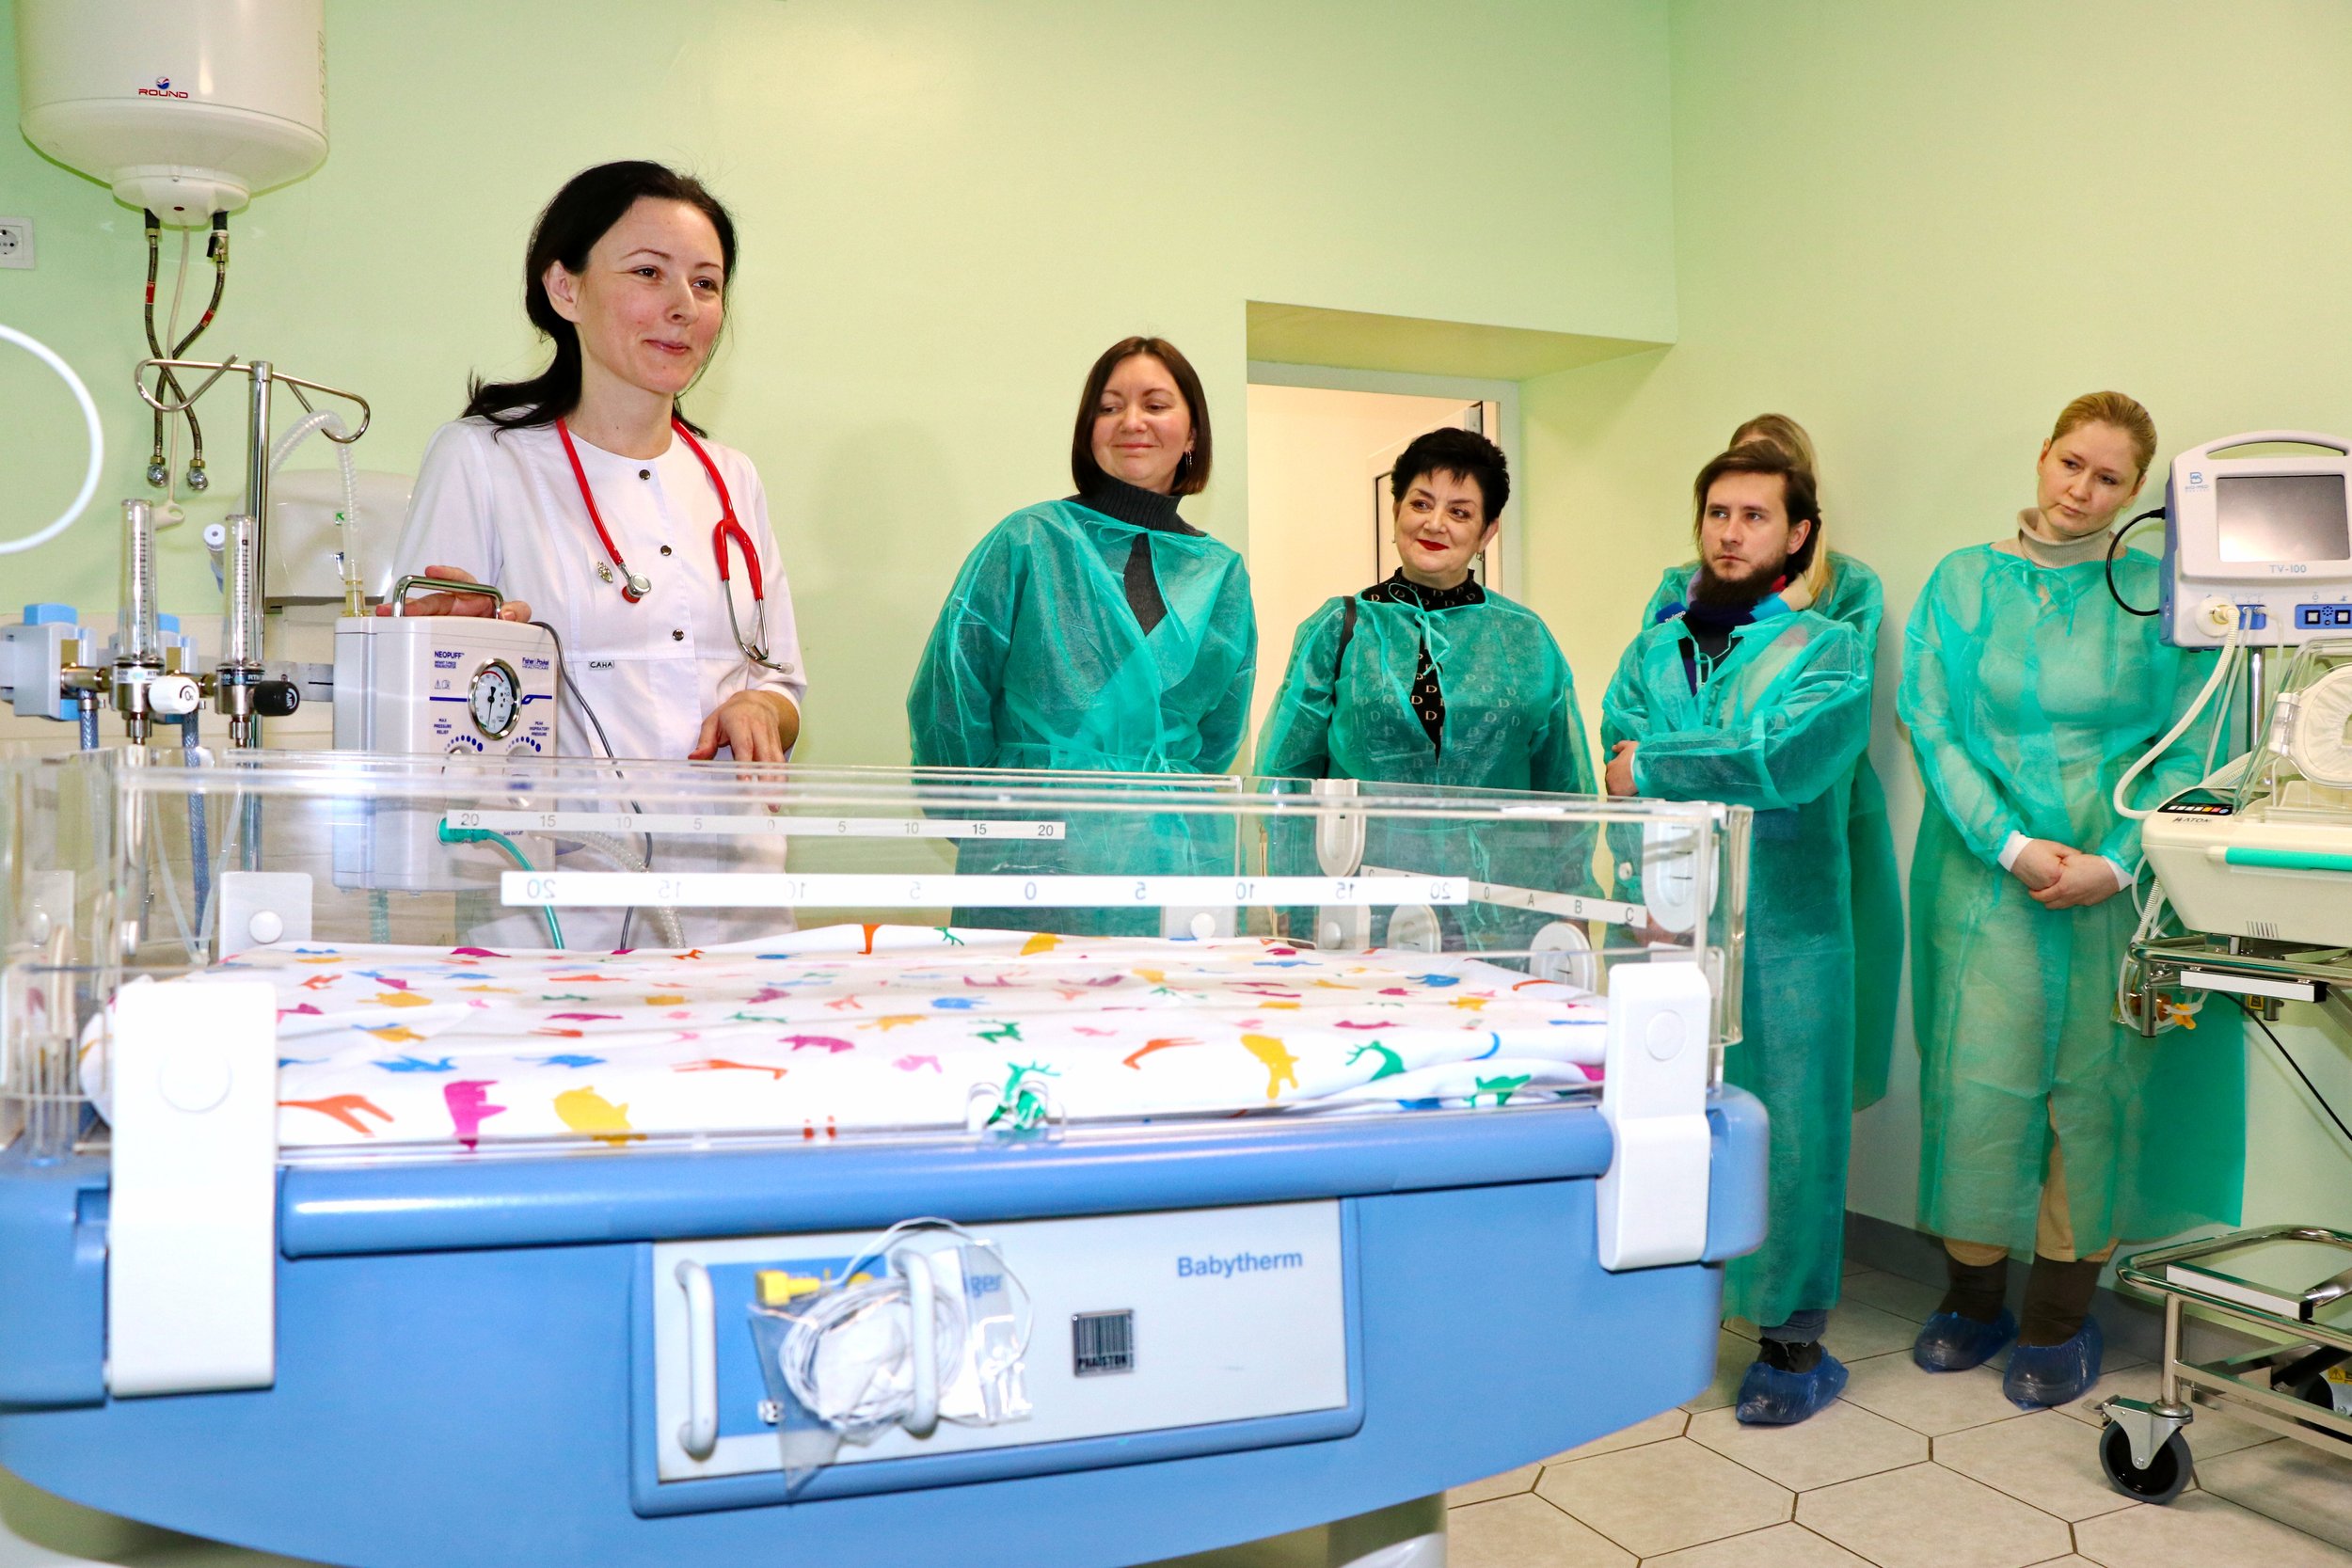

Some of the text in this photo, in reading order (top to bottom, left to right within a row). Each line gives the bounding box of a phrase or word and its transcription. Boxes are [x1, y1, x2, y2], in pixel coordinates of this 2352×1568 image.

[138, 88, 189, 99] ROUND
[2269, 564, 2307, 574] TV-100
[460, 813, 1054, 837] 20 15 10 5 0 5 10 15 20
[1527, 893, 1535, 908] A
[1574, 899, 1582, 914] B
[1625, 907, 1635, 923] C
[1178, 1252, 1304, 1278] Babytherm
